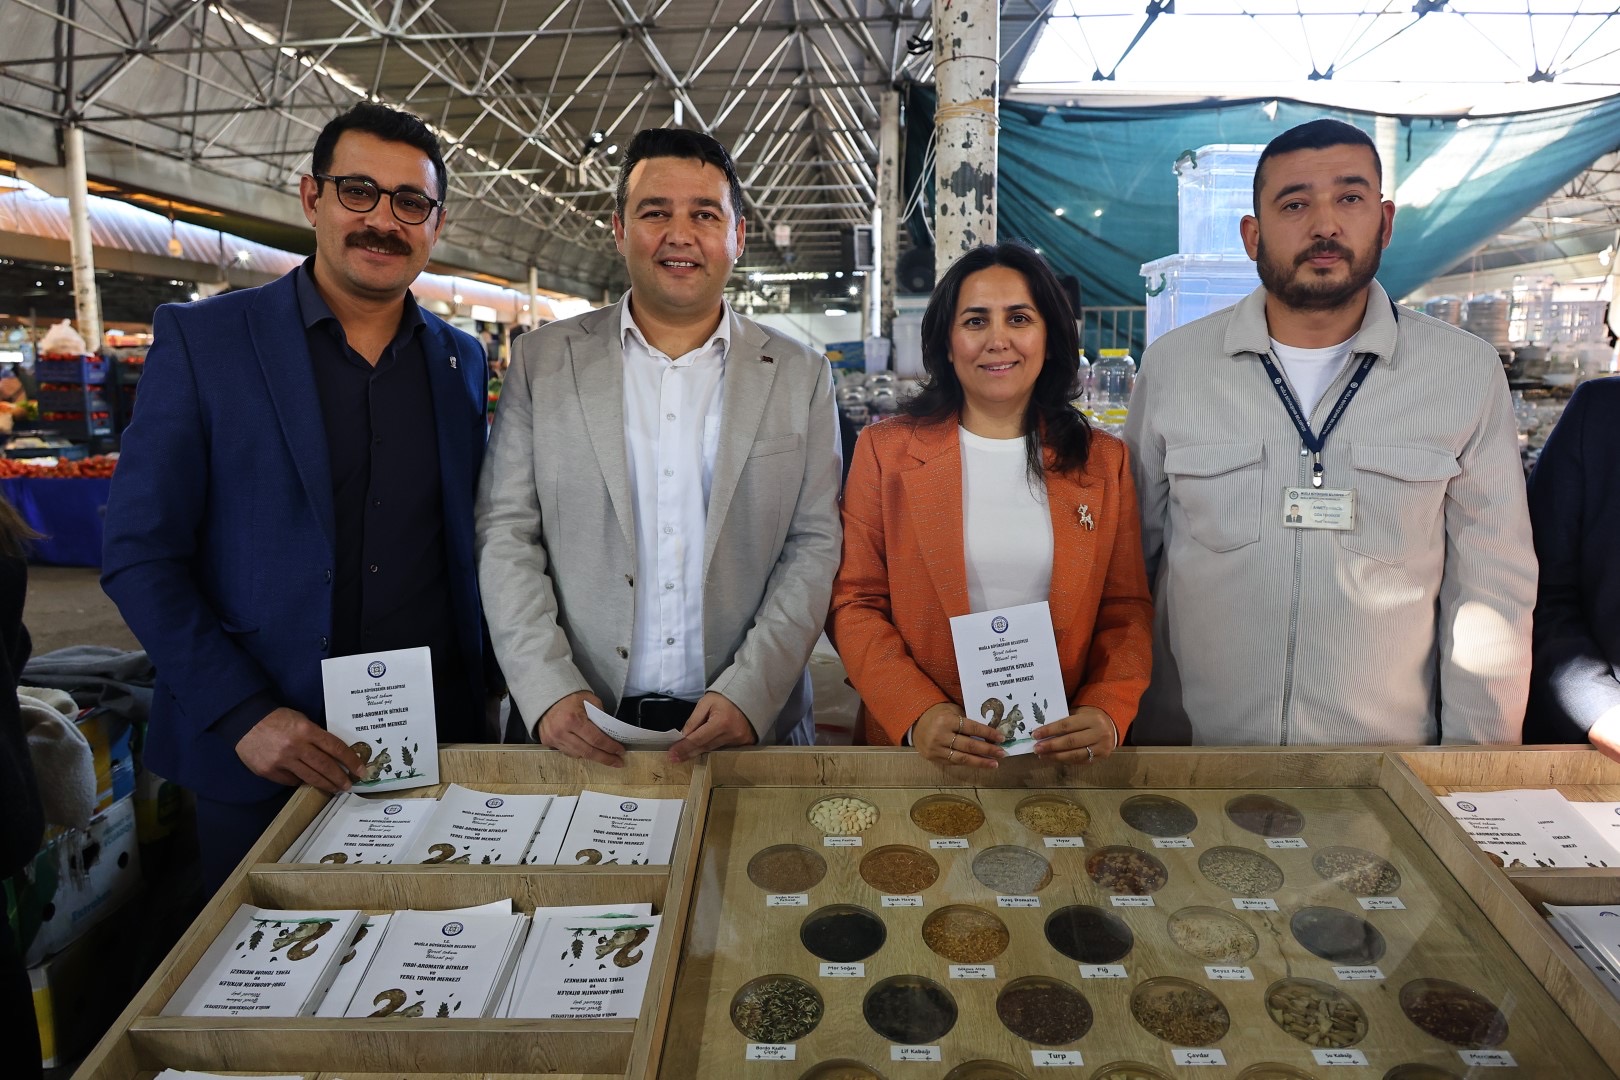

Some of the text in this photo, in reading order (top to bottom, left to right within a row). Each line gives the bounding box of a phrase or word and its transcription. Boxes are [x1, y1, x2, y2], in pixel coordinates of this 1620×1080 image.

[982, 666, 1015, 675] TIBBİ-AROMATİK
[352, 710, 388, 719] TIBBİ-AROMATİK
[1048, 1053, 1066, 1061] Turp
